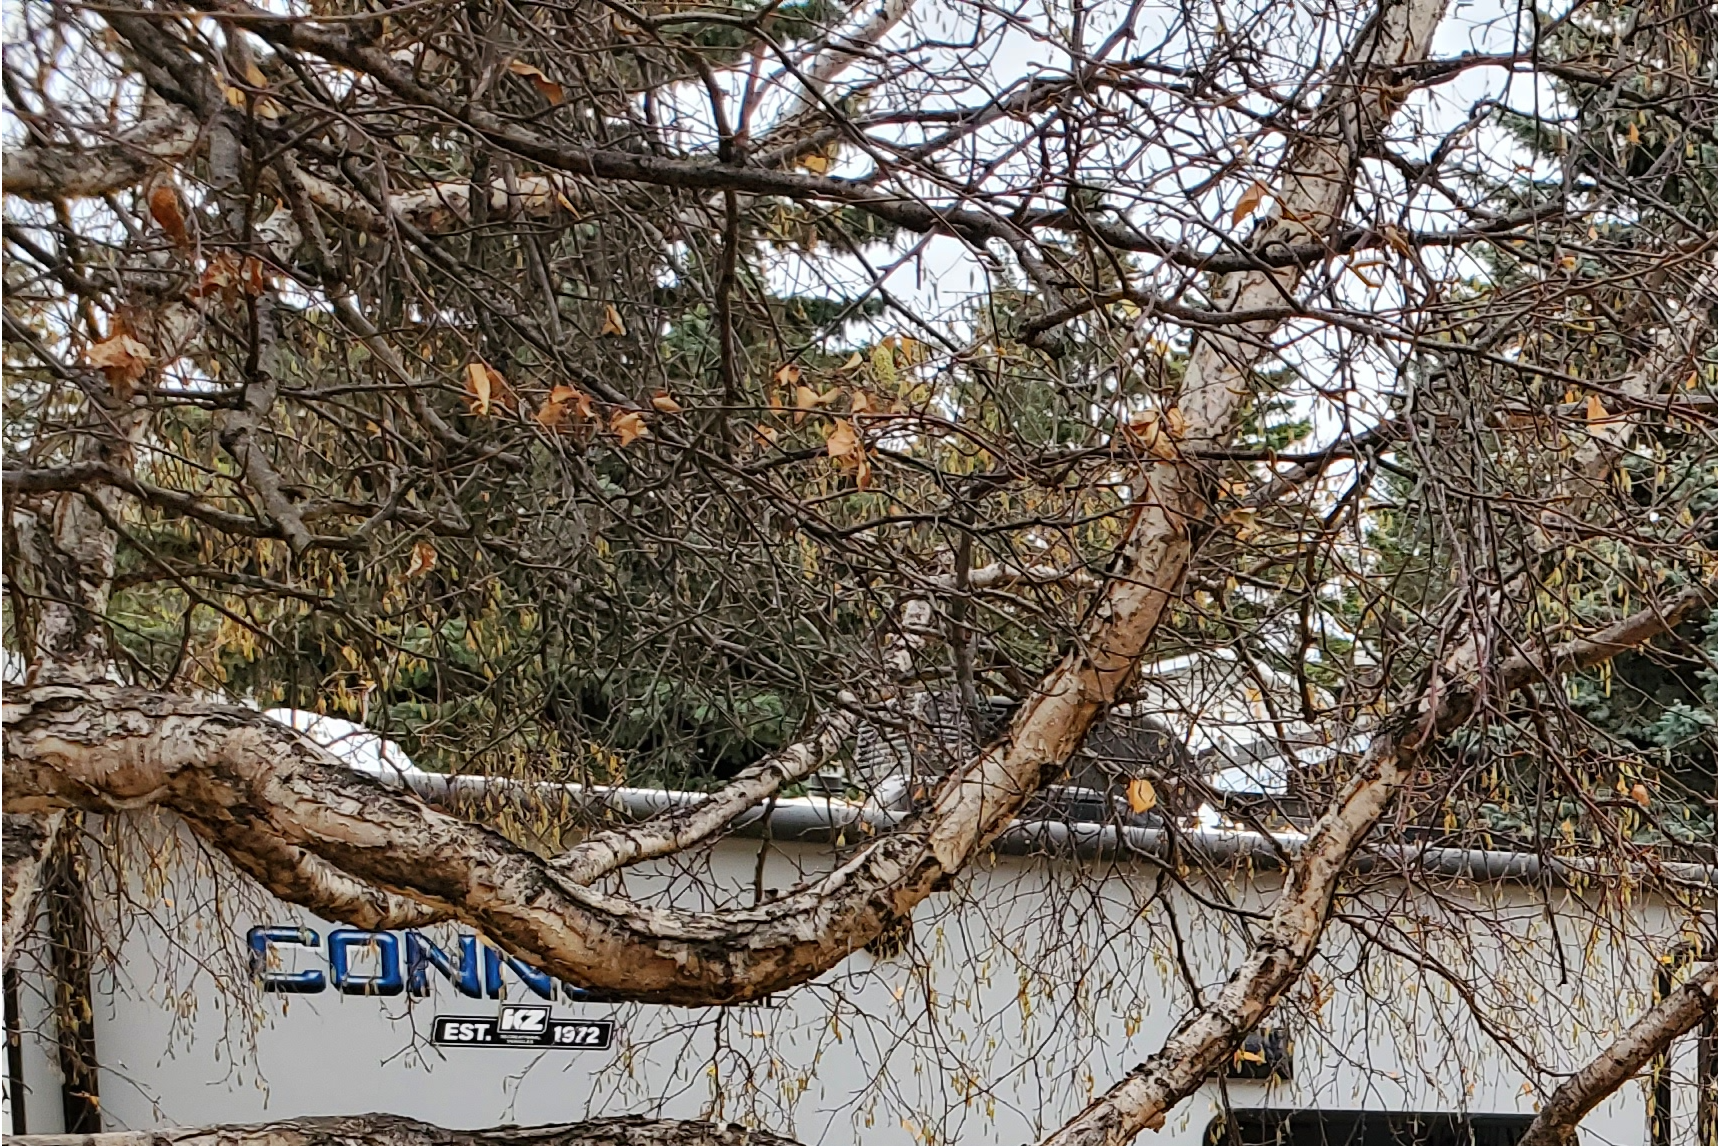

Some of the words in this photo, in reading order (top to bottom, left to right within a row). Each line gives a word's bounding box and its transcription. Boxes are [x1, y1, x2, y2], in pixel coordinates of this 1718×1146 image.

[247, 926, 596, 1003] CONN
[501, 1008, 547, 1031] KZ
[443, 1022, 492, 1042] EST.
[553, 1025, 600, 1044] 1972
